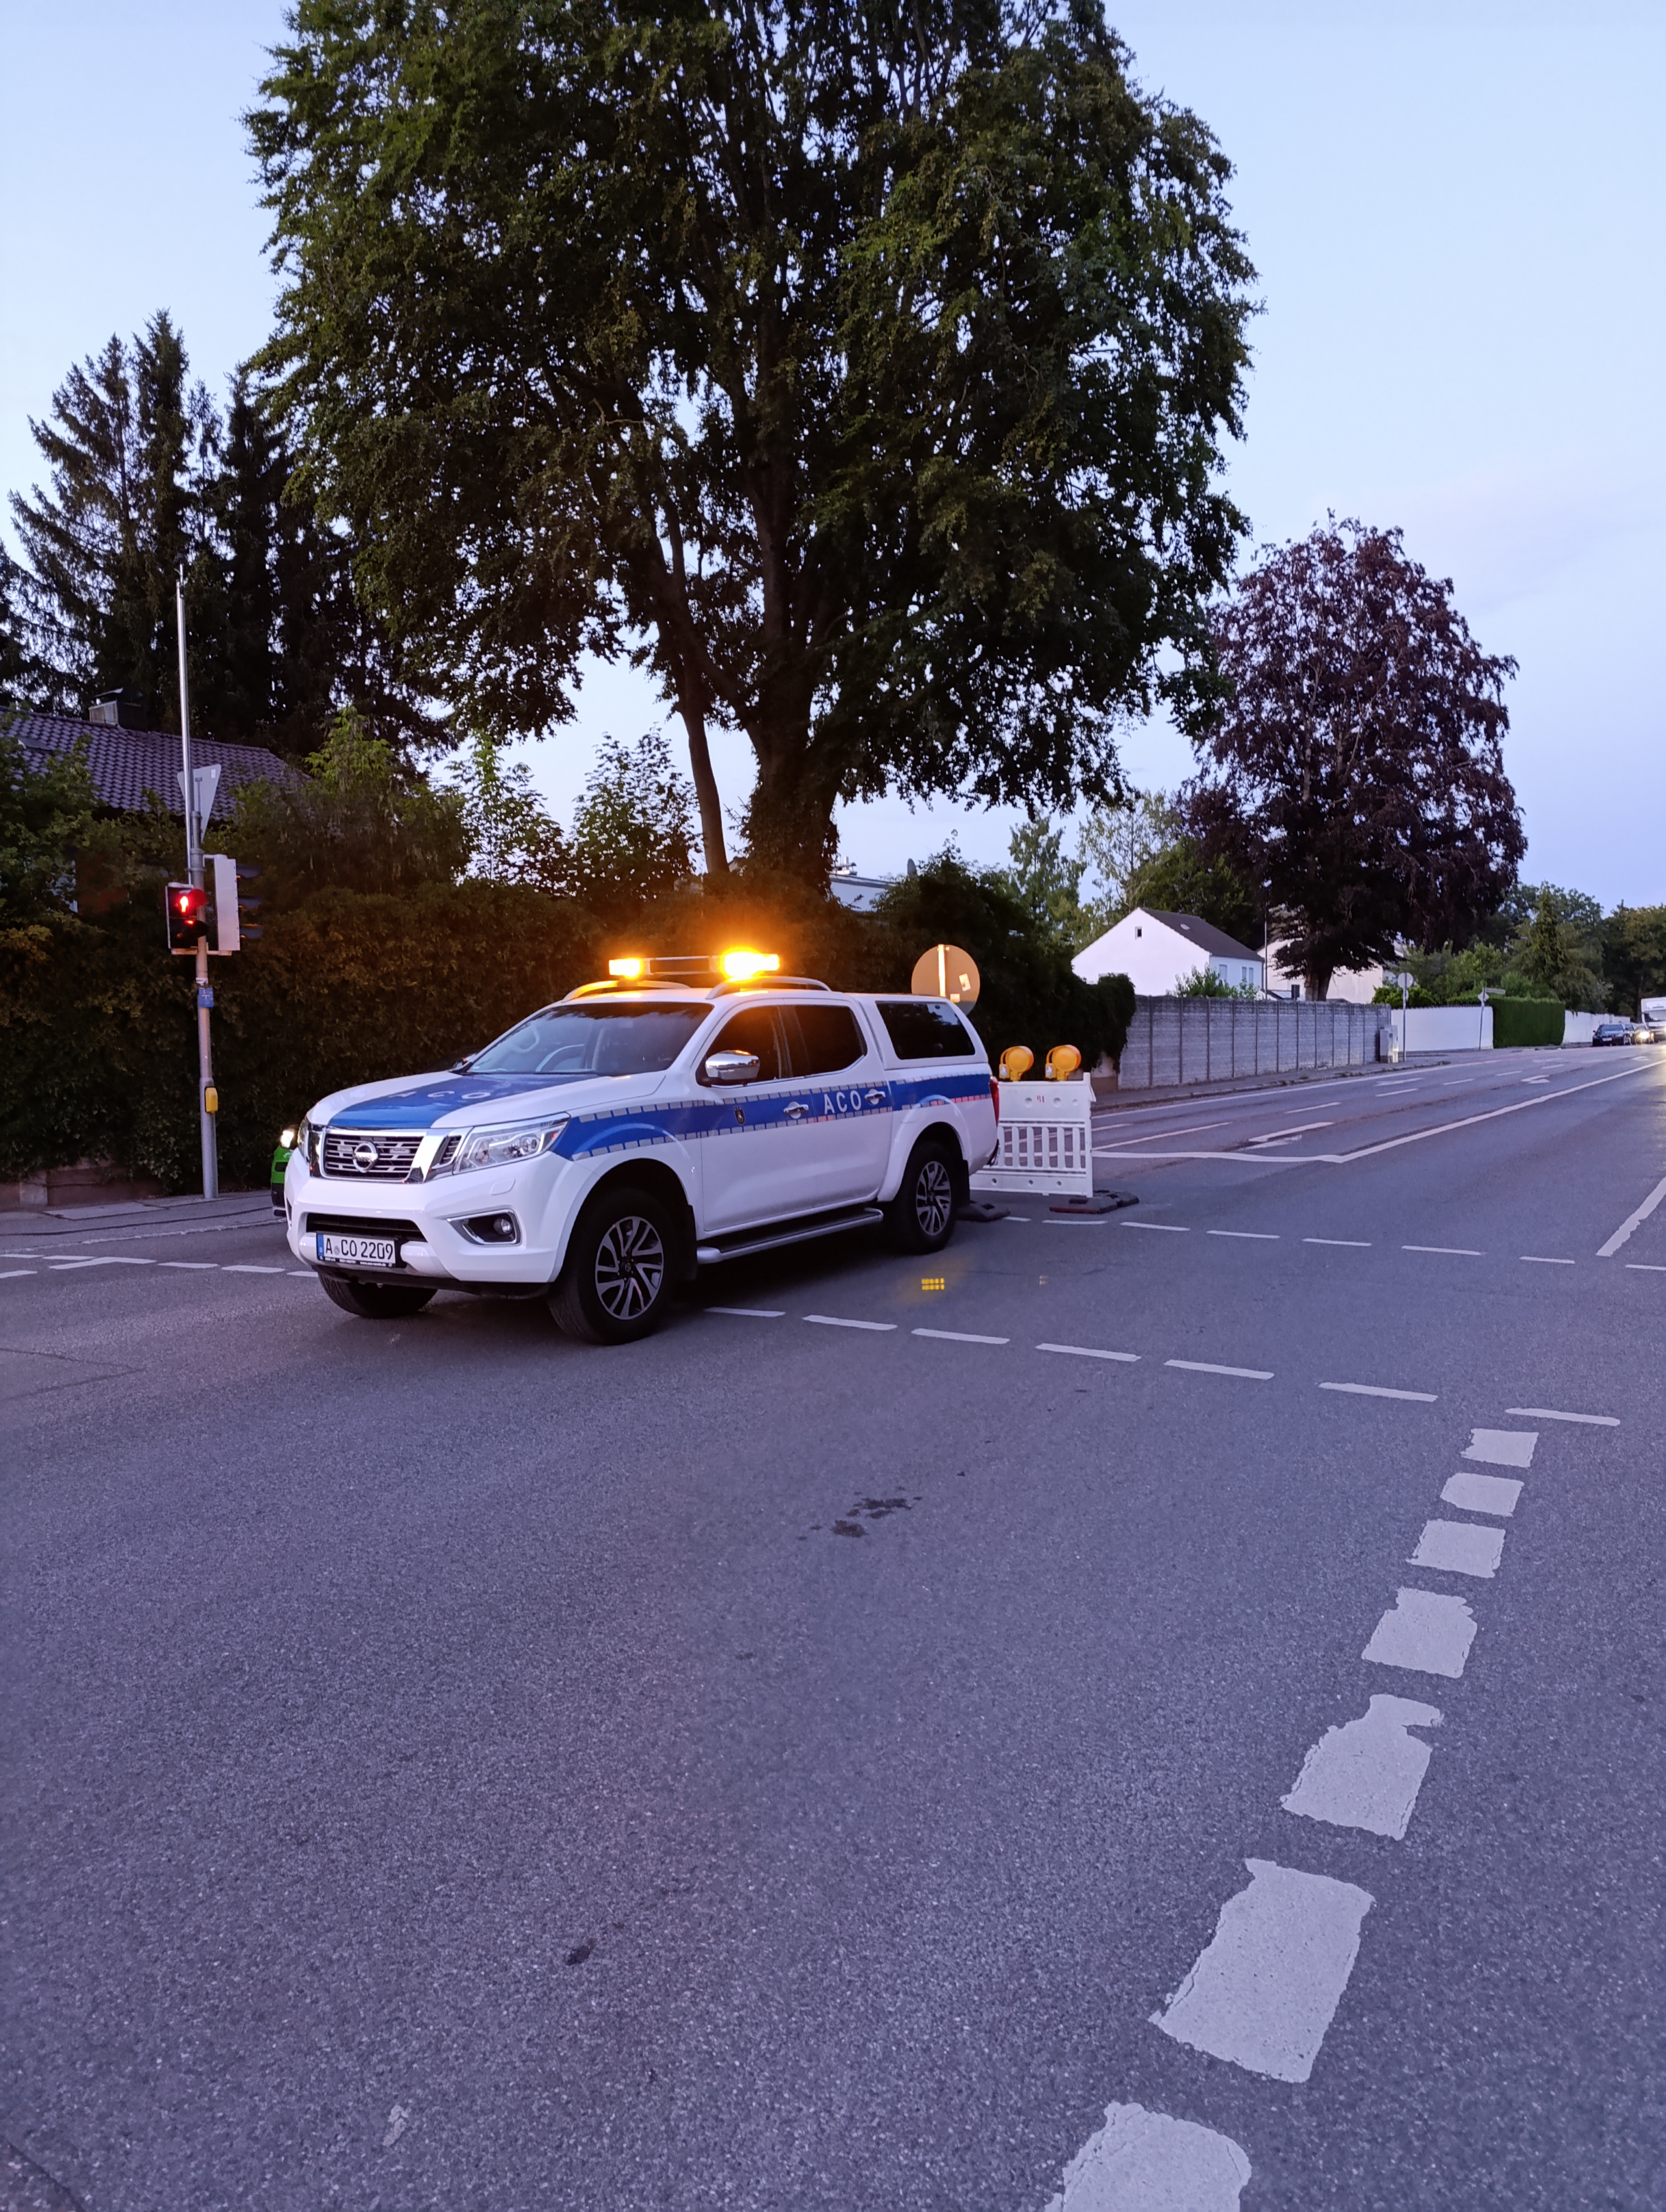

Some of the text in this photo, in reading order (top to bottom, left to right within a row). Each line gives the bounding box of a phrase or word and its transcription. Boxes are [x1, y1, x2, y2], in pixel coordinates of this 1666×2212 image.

[824, 1090, 861, 1115] ACO
[325, 1238, 393, 1260] A CO 2209
